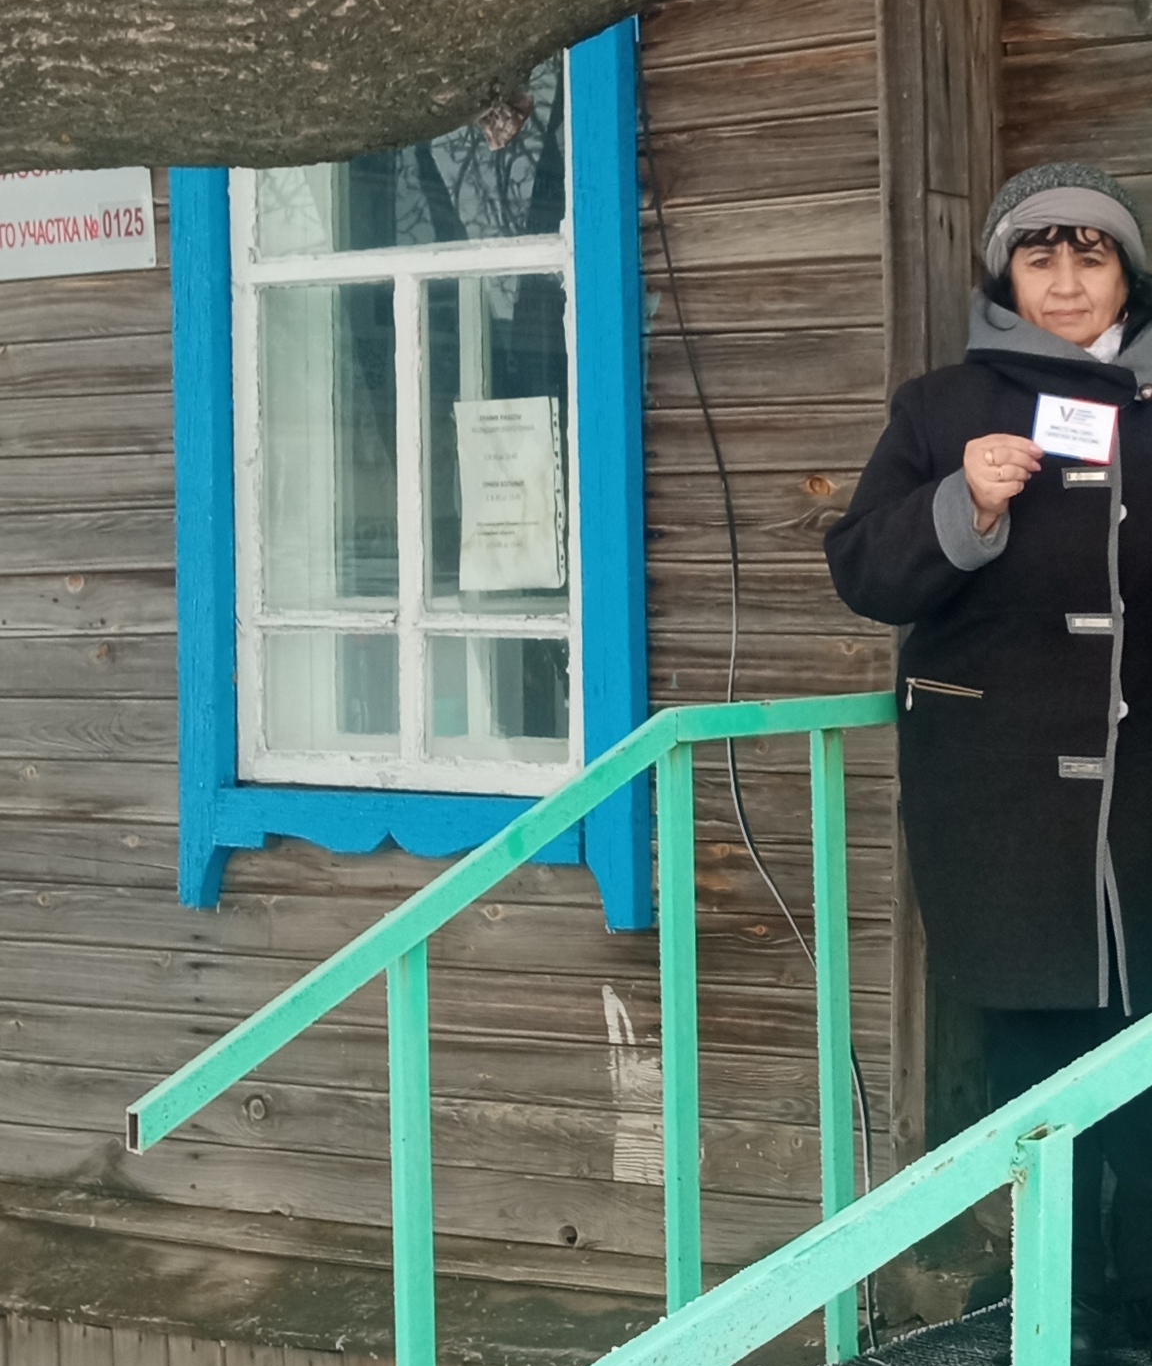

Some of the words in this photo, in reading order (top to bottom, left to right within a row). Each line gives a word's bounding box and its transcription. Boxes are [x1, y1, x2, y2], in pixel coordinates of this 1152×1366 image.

[18, 215, 81, 247] УЧАСТКА
[84, 215, 99, 241] №
[102, 207, 144, 239] 0125
